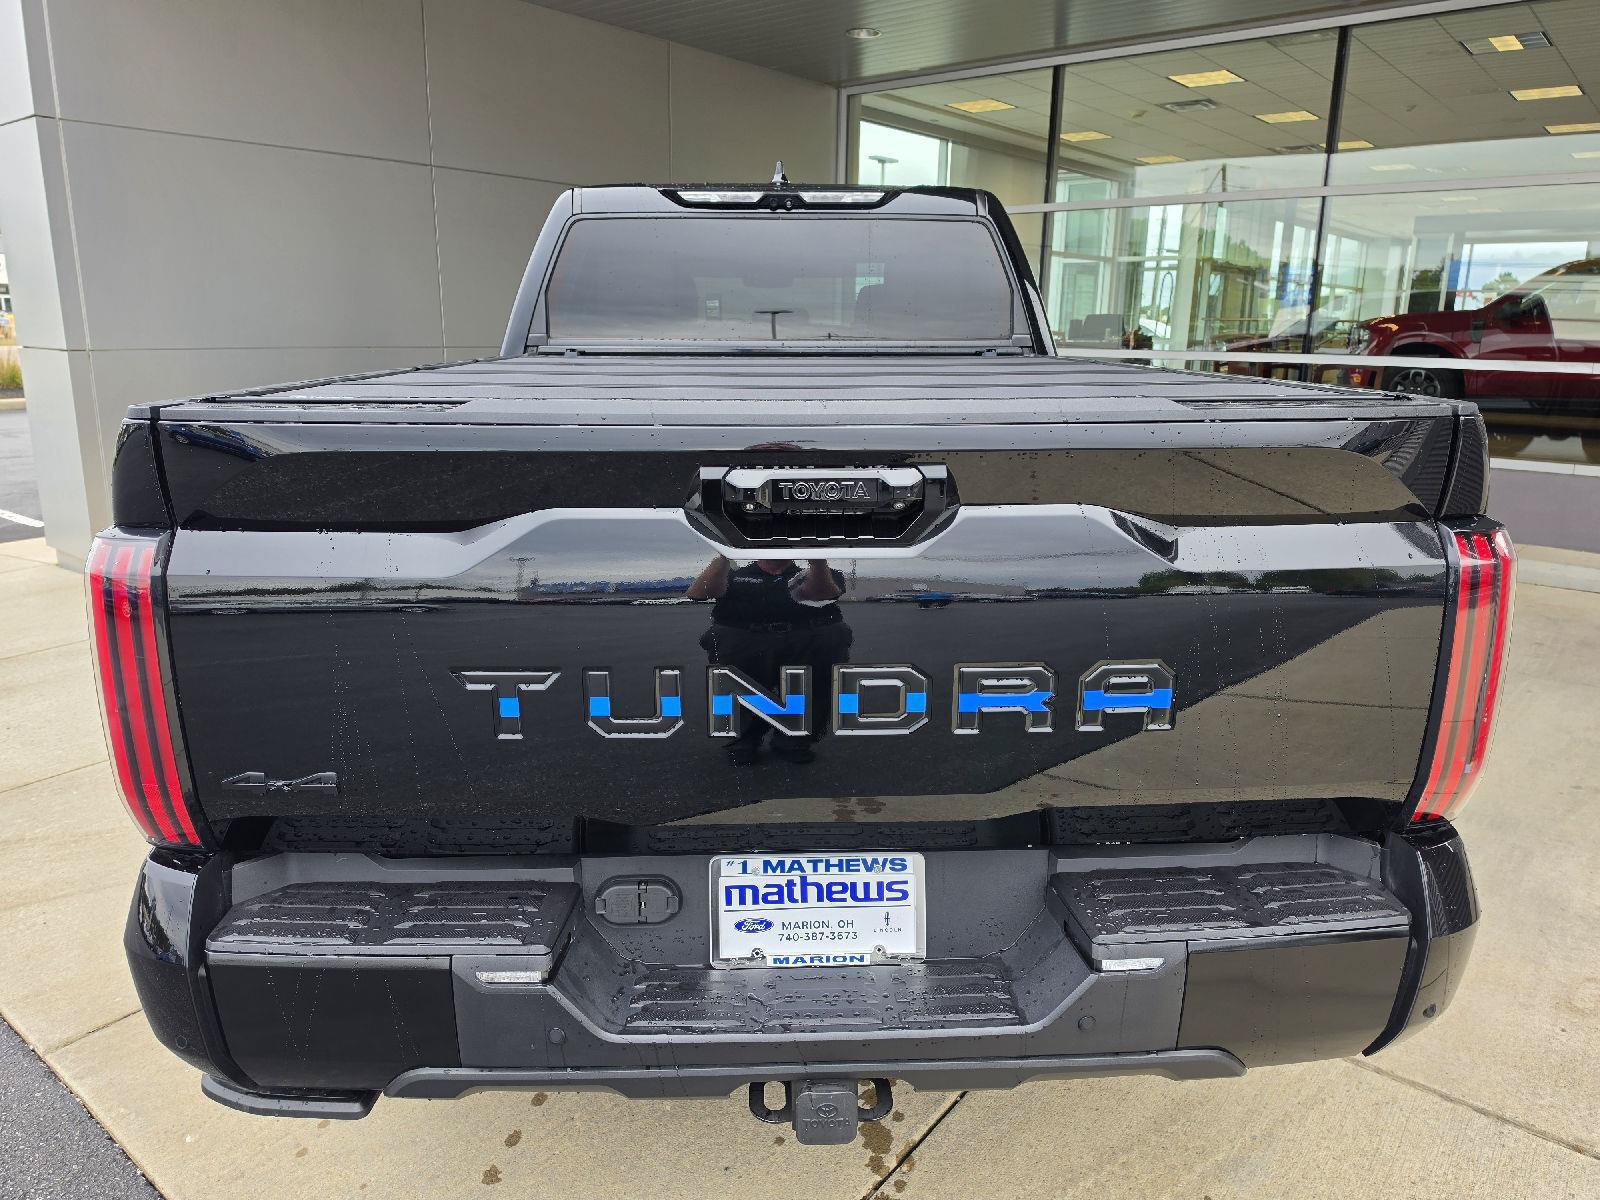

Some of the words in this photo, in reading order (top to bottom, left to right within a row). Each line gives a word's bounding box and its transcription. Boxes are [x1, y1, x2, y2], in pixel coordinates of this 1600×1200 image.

[778, 481, 871, 501] TOYOTA
[449, 658, 1178, 739] TUNDRA
[762, 857, 908, 875] MATHEWS
[725, 875, 909, 906] mathews
[740, 919, 767, 932] Ford
[837, 919, 854, 929] OH
[772, 954, 865, 965] MARION
